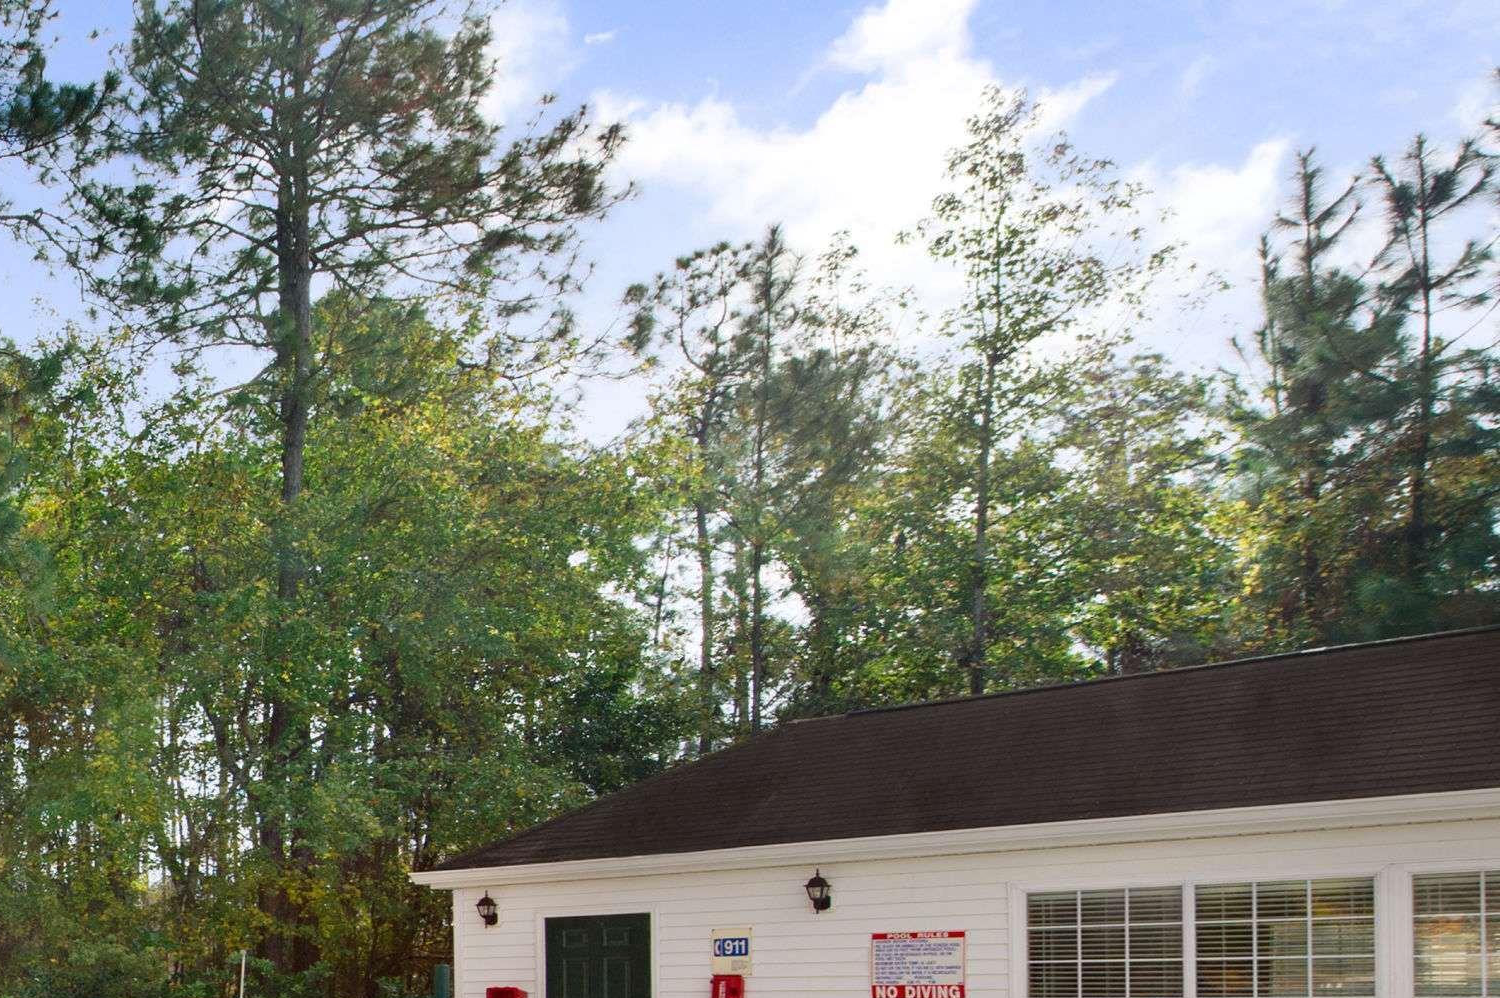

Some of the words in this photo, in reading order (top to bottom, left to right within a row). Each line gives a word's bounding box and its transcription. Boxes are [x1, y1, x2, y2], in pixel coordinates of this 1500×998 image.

[723, 940, 746, 954] 911
[875, 985, 898, 998] NO
[905, 985, 961, 998] DIVING
